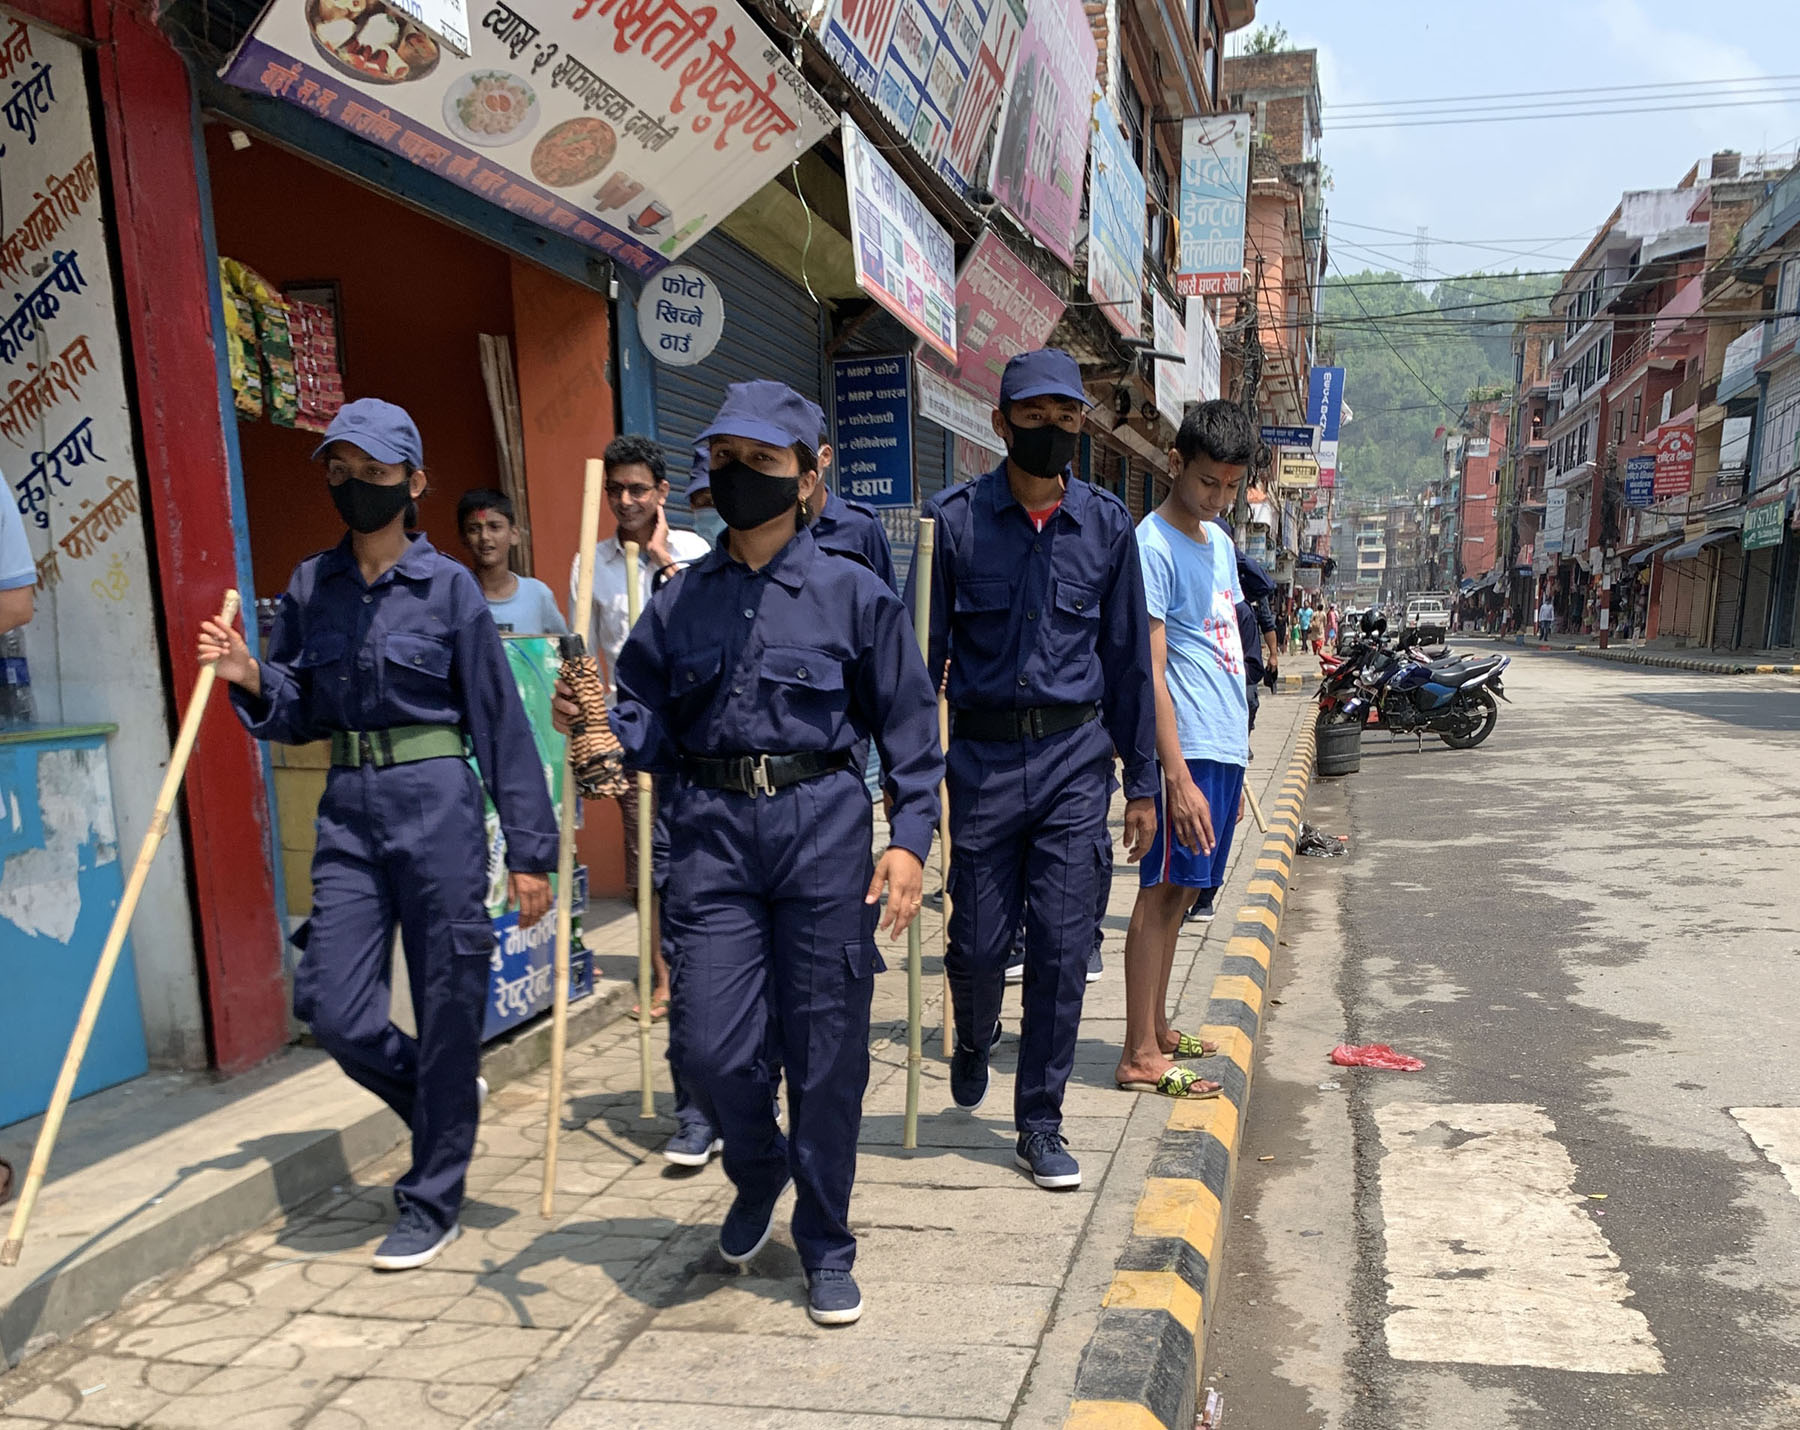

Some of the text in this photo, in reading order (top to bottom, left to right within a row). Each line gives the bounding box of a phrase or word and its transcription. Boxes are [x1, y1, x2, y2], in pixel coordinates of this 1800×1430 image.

[2, 61, 58, 145] फोटो
[1183, 191, 1241, 228] डेन्टल
[1182, 228, 1241, 269] क्लिनिक
[661, 273, 706, 299] फोटो
[847, 367, 871, 377] MRP
[848, 391, 873, 401] MRP
[17, 416, 106, 528] कुरियर
